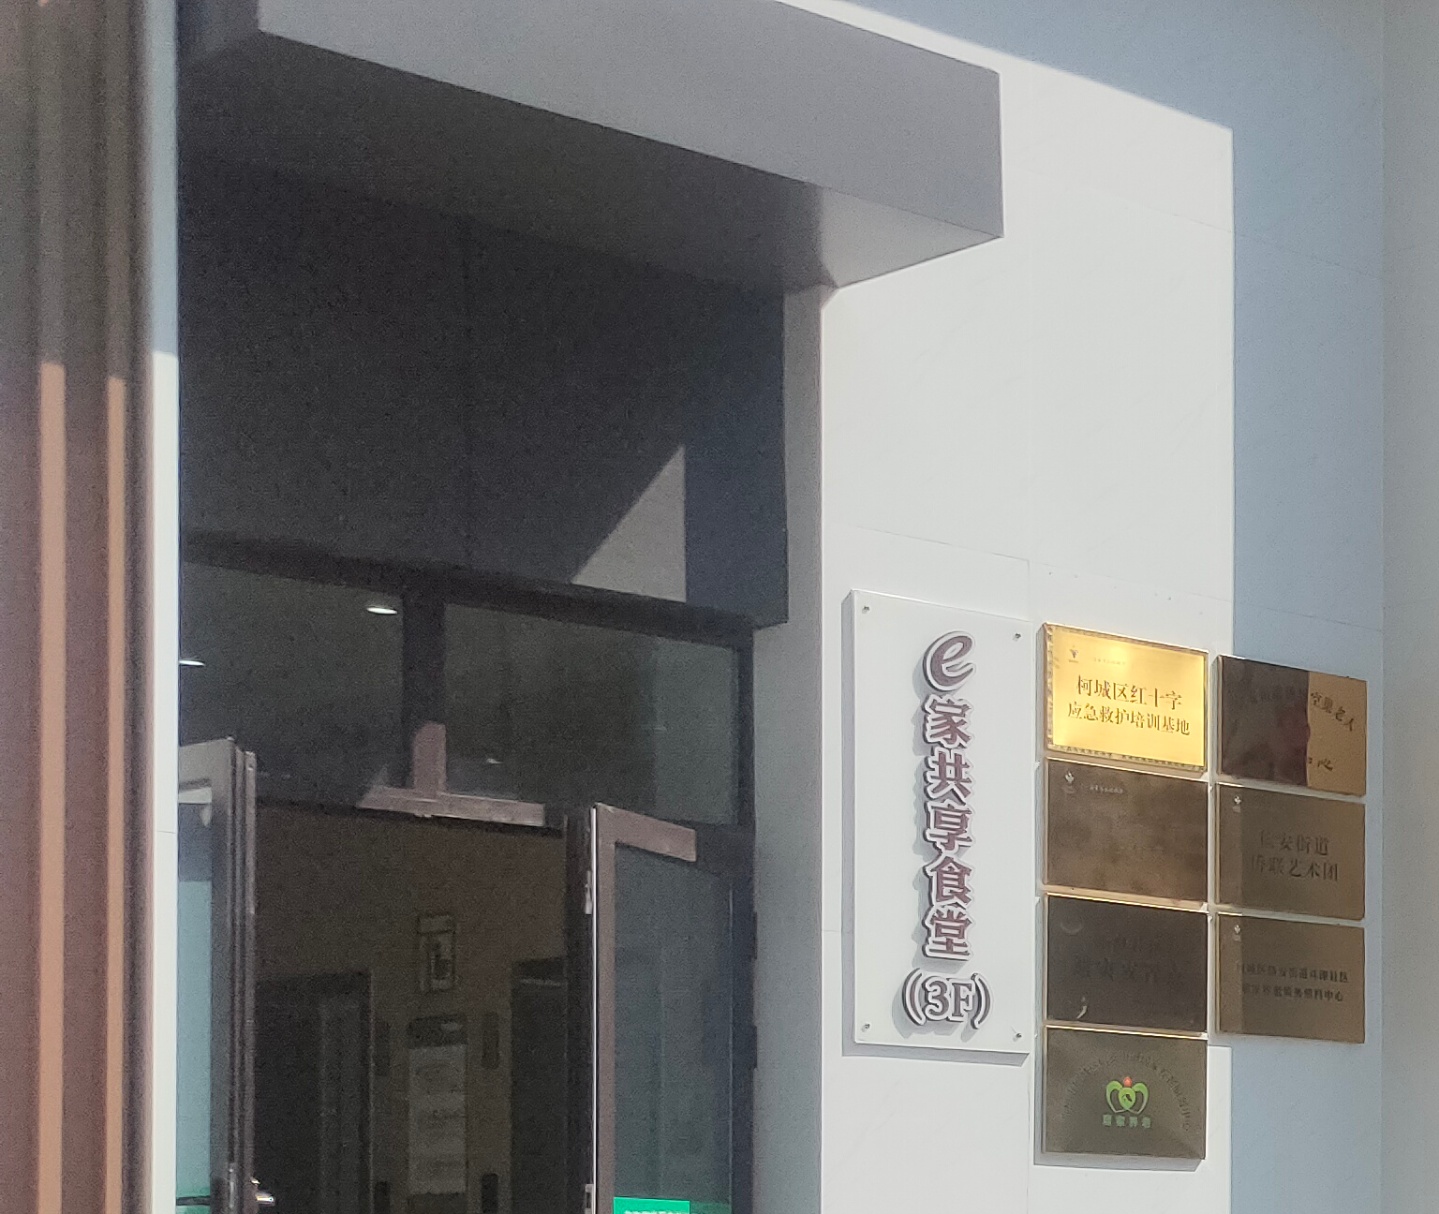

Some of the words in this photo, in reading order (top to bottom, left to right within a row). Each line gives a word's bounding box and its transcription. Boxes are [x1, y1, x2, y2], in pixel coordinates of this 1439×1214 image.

[1077, 674, 1183, 710] 柯城区红十字
[1068, 701, 1191, 736] 应急救护培训基地
[923, 630, 976, 960] e家共享食堂
[902, 967, 992, 1029] (3F)
